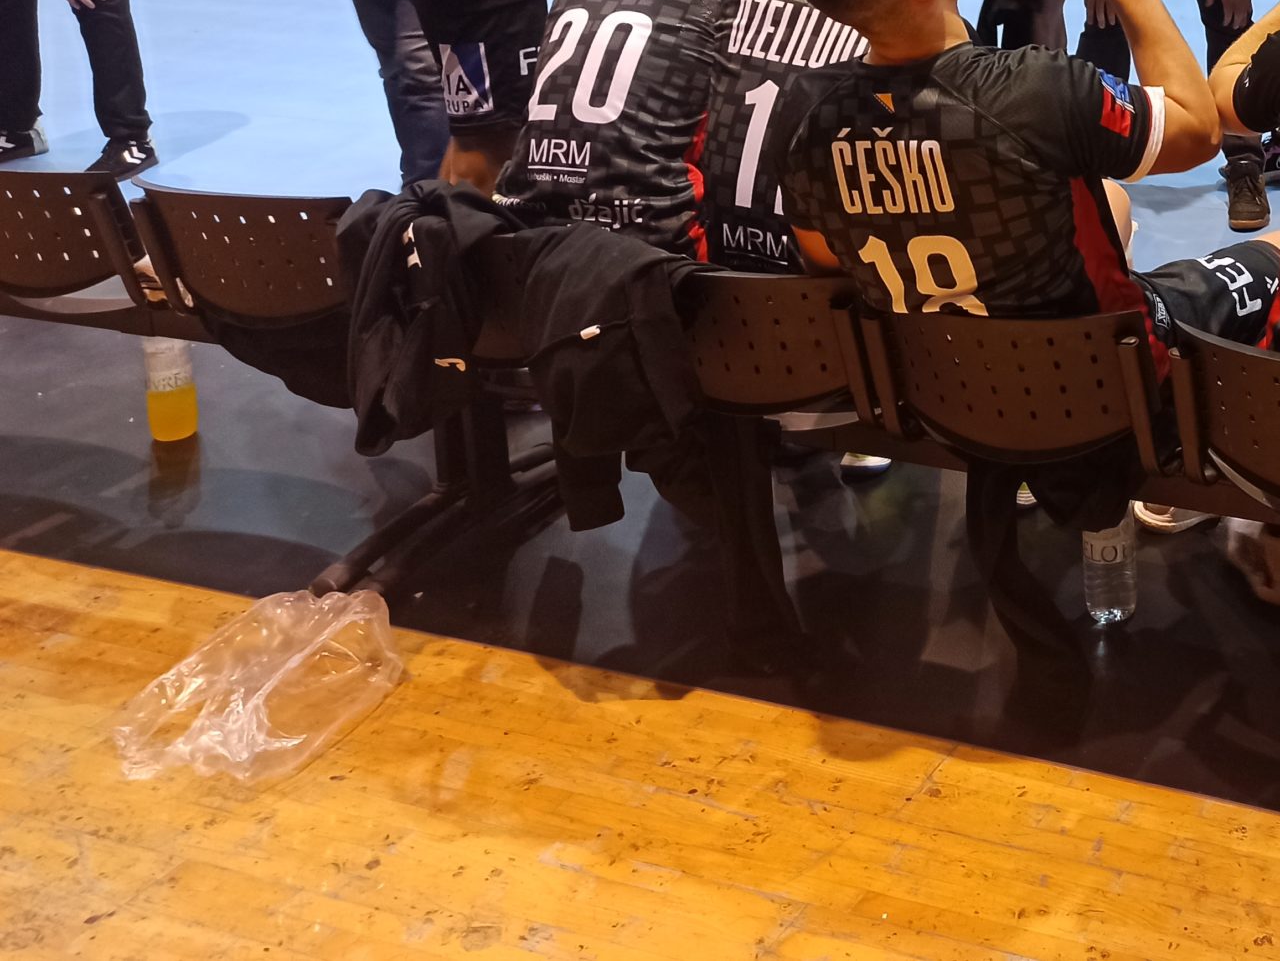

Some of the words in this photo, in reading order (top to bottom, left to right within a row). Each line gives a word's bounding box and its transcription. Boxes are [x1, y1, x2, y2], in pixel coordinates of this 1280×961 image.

[527, 7, 652, 125] 20
[528, 138, 591, 167] MRM
[831, 126, 955, 215] ĆEŠKO
[722, 222, 788, 257] MRM
[857, 235, 989, 316] 18
